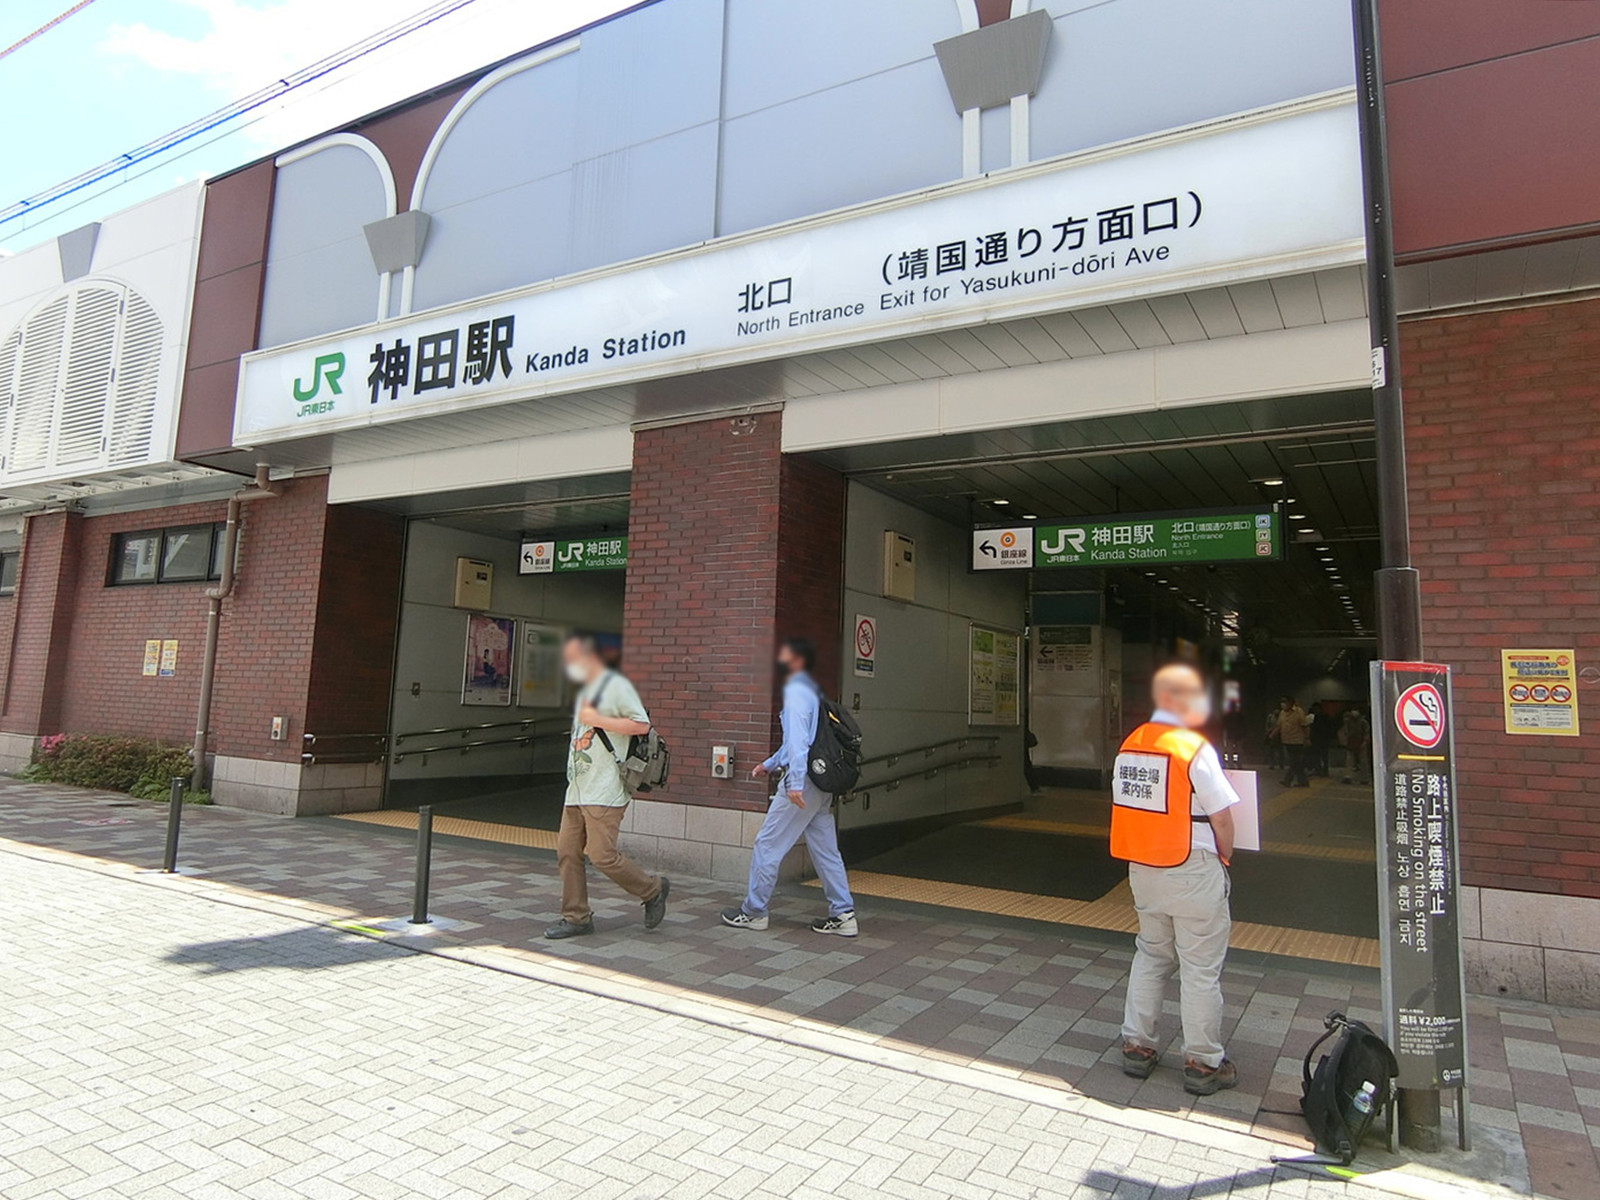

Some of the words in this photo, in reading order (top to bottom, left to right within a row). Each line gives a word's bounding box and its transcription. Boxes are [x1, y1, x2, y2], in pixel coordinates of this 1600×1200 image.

[737, 315, 781, 337] North
[788, 302, 865, 328] Entrance
[879, 291, 916, 312] Exit
[922, 285, 949, 303] for
[960, 252, 1117, 295] Yasukuni-dōri
[1125, 243, 1170, 266] Ave
[737, 276, 793, 314] 北口
[367, 314, 516, 405] 神田駅
[525, 346, 590, 374] Kanda
[602, 328, 686, 361] Station
[293, 351, 346, 402] JR
[1091, 524, 1154, 546] 神田駅
[1171, 522, 1194, 533] 北口
[558, 542, 584, 562] JR
[586, 540, 622, 556] 神田駅
[1041, 528, 1085, 554] JR
[1090, 548, 1125, 560] Kanda
[1128, 547, 1167, 559] Station
[585, 558, 605, 567] Kanda
[1412, 774, 1425, 793] No
[1410, 797, 1426, 857] Smoking
[1427, 774, 1446, 914] 路上喫煙禁止
[1413, 861, 1425, 880] on
[1414, 883, 1428, 908] the
[1415, 911, 1428, 953] street
